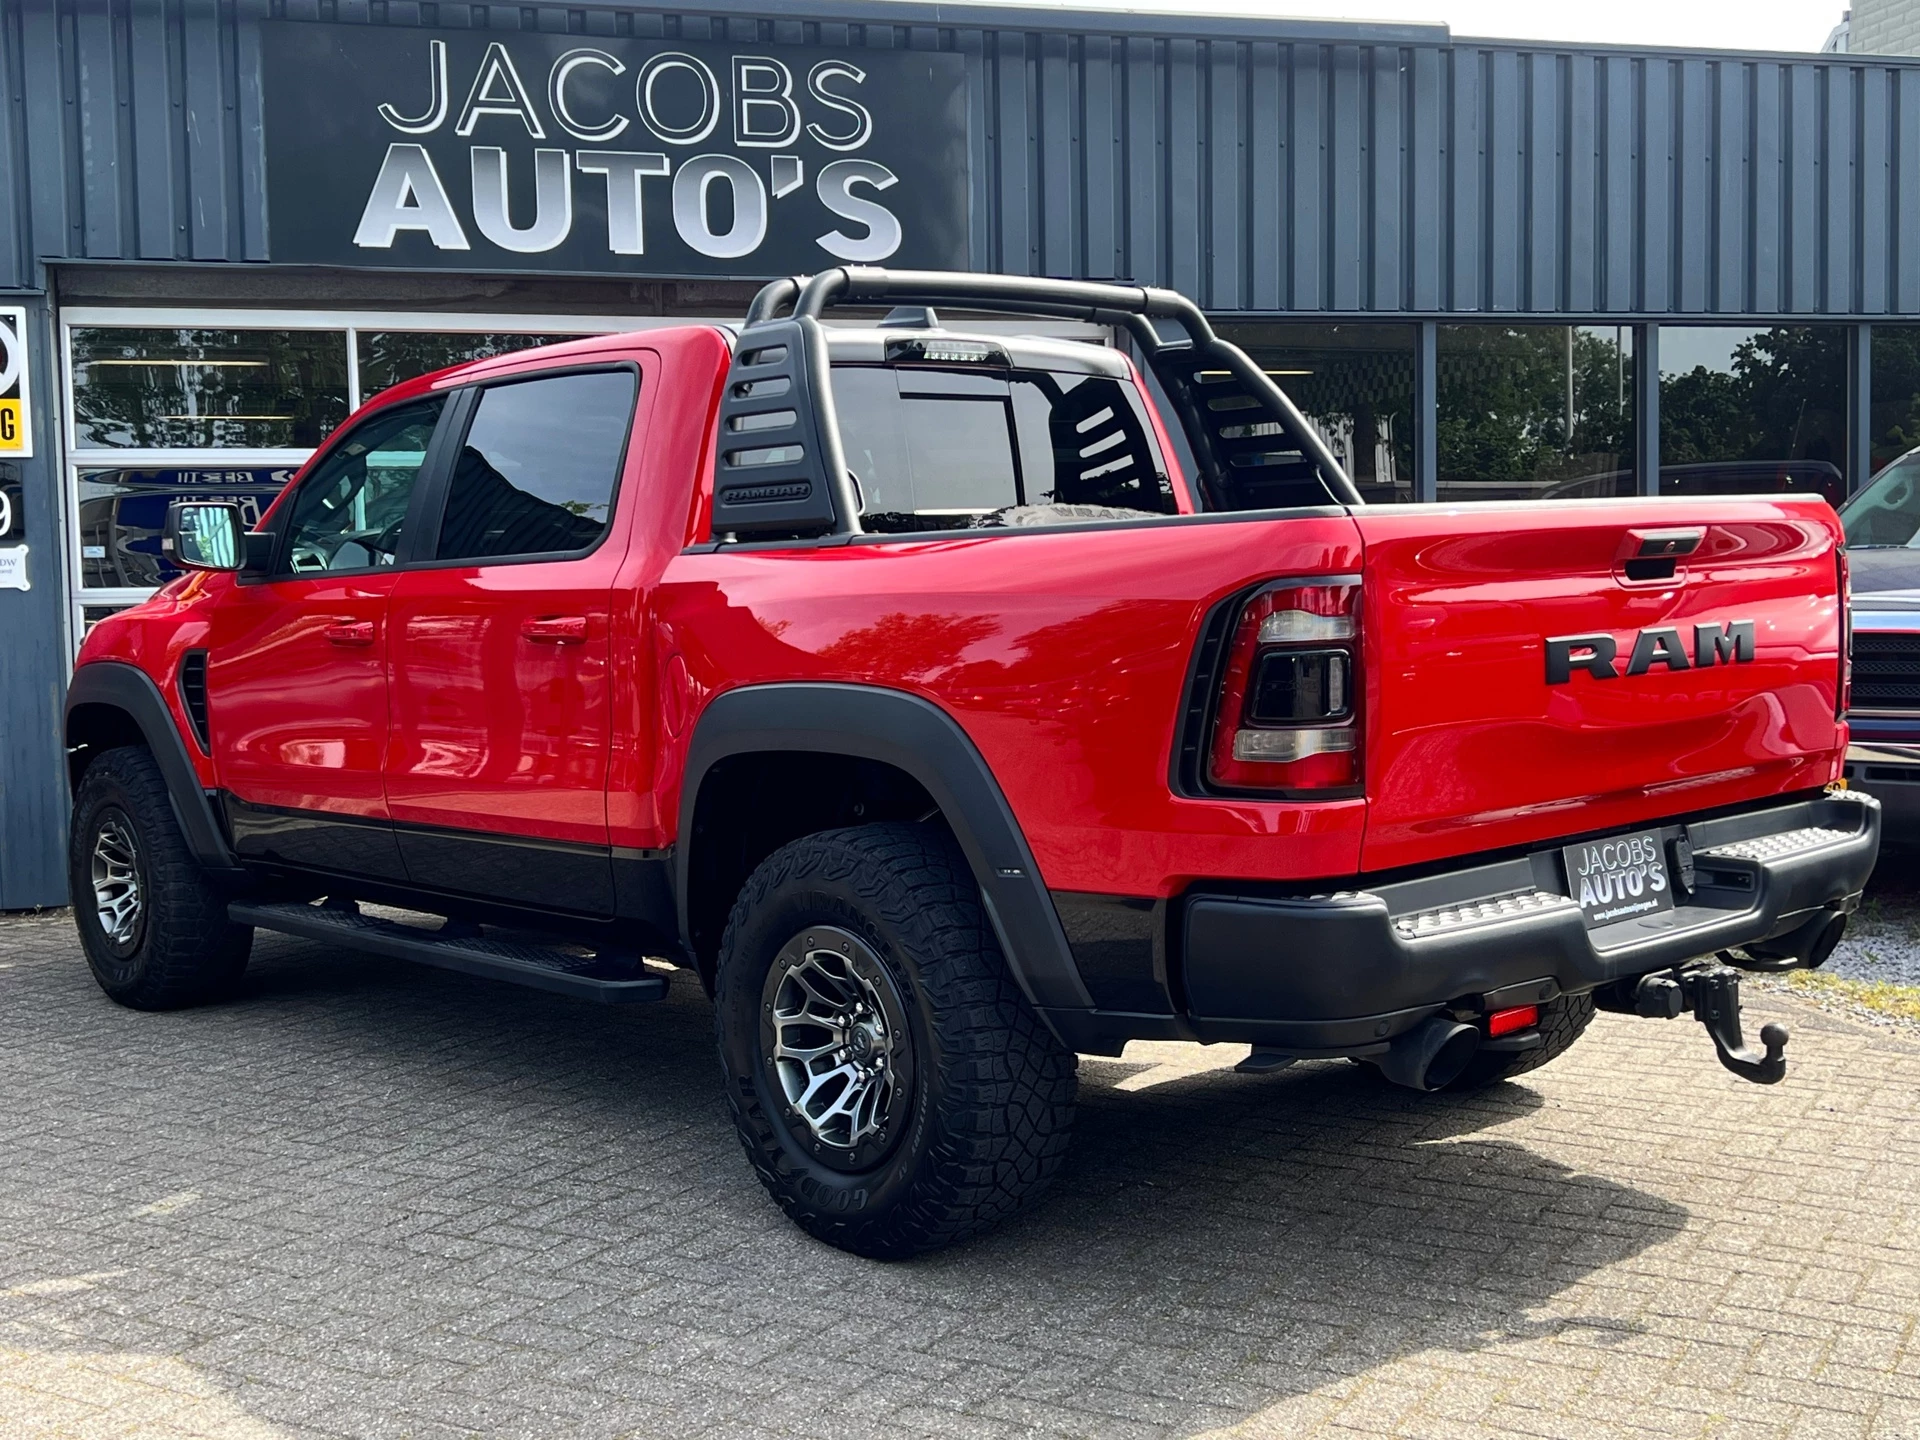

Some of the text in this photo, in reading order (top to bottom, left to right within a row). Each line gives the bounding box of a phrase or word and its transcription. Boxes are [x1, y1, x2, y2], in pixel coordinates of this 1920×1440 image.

[377, 39, 873, 152] JACOBS
[352, 142, 903, 263] AUTO'S
[725, 485, 808, 502] RAMBAR
[1544, 618, 1755, 686] RAM
[1577, 835, 1657, 876] JACOBS
[1579, 861, 1667, 909] AUTO'S
[791, 889, 916, 1007] WRANGLER
